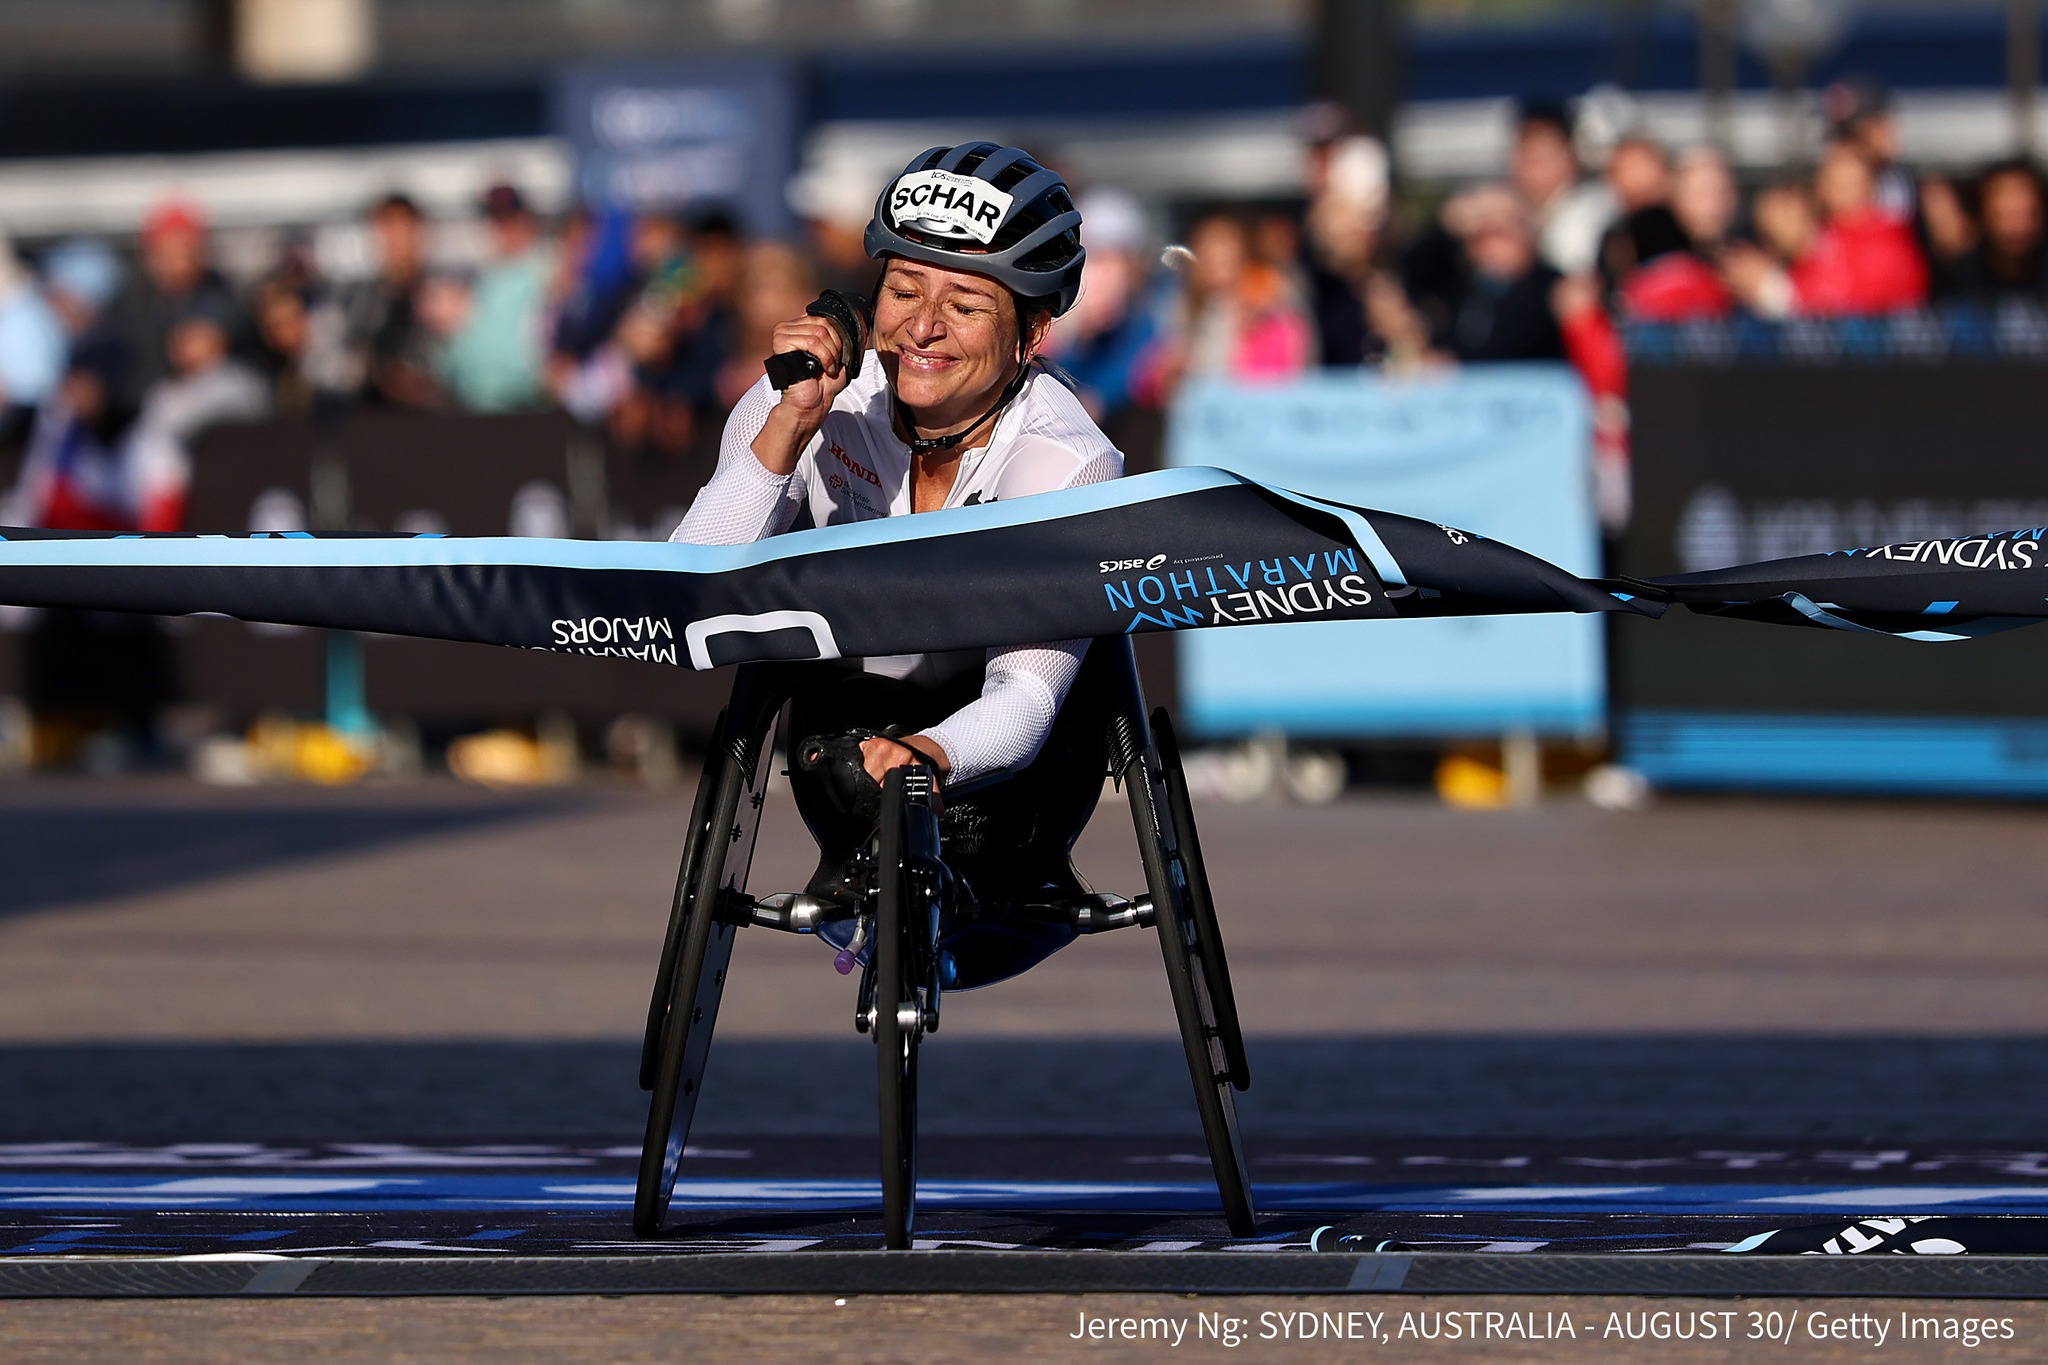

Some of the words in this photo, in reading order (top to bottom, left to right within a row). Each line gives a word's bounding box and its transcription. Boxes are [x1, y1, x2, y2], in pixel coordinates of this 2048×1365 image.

[893, 184, 1001, 230] SCHAR
[1173, 557, 1184, 566] by
[1185, 552, 1224, 564] presented
[1104, 547, 1359, 612] MARATHON
[1211, 574, 1372, 625] SYDNEY
[551, 616, 674, 645] MAJORS
